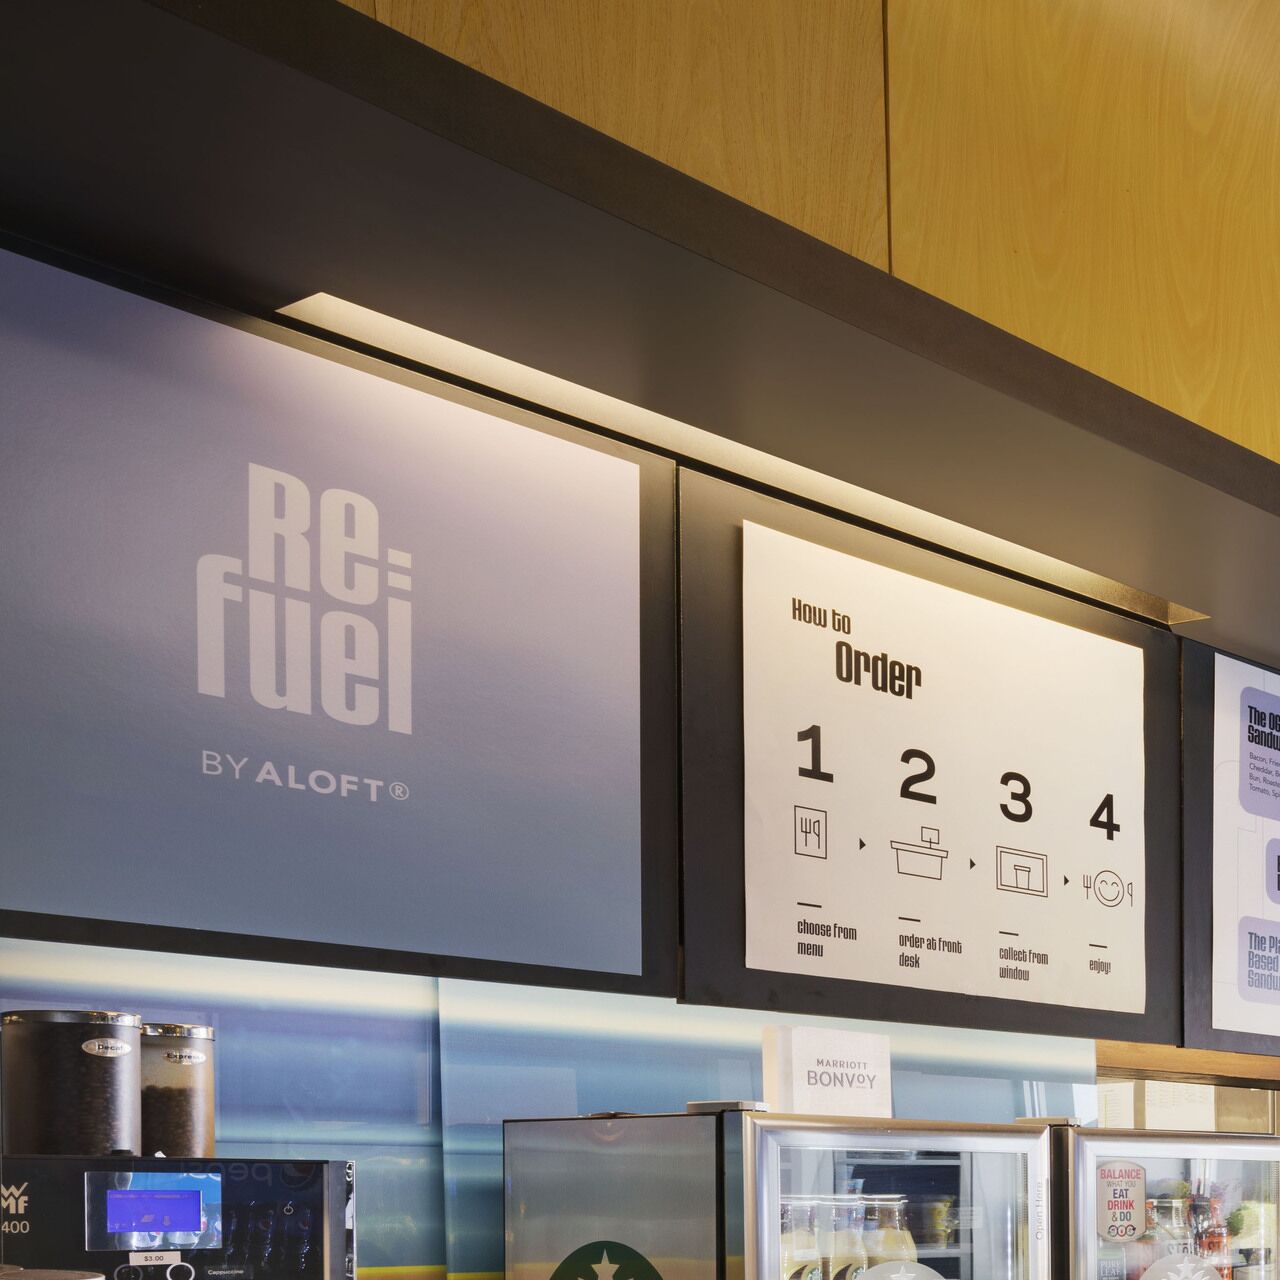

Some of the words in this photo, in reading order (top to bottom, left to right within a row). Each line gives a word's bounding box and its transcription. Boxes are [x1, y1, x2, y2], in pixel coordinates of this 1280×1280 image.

[792, 598, 828, 629] How
[831, 609, 851, 635] to
[196, 553, 413, 735] fuel
[835, 640, 922, 700] Order
[1248, 705, 1267, 728] The
[1269, 712, 1280, 732] OG
[797, 724, 834, 783] 1
[1249, 752, 1268, 763] Bacon,
[201, 750, 248, 779] BY
[1249, 763, 1274, 776] Cheddar,
[900, 748, 937, 804] 2
[1249, 772, 1262, 783] Bun,
[999, 772, 1034, 822] 3
[1249, 783, 1271, 796] Tomato,
[1089, 793, 1121, 841] 4
[797, 919, 831, 938] choose
[833, 922, 857, 941] from
[797, 940, 824, 957] menu
[899, 933, 925, 950] order
[926, 935, 937, 951] at
[938, 937, 962, 954] front
[1248, 931, 1267, 951] The
[899, 951, 920, 968] desk
[999, 946, 1027, 963] collect
[1028, 949, 1049, 965] from
[1248, 950, 1279, 972] Based
[999, 965, 1030, 981] window
[1089, 958, 1111, 975] enjoy!
[816, 1058, 867, 1070] MARRIOTT
[807, 1070, 876, 1089] BONVOY
[1100, 1168, 1141, 1180] BALANCE
[1112, 1188, 1129, 1199] EAT
[1107, 1200, 1135, 1211] DRINK
[1111, 1213, 1118, 1222] &
[1119, 1211, 1132, 1222] DO
[144, 1255, 164, 1263] $3.00
[207, 1268, 245, 1277] Cappuccino
